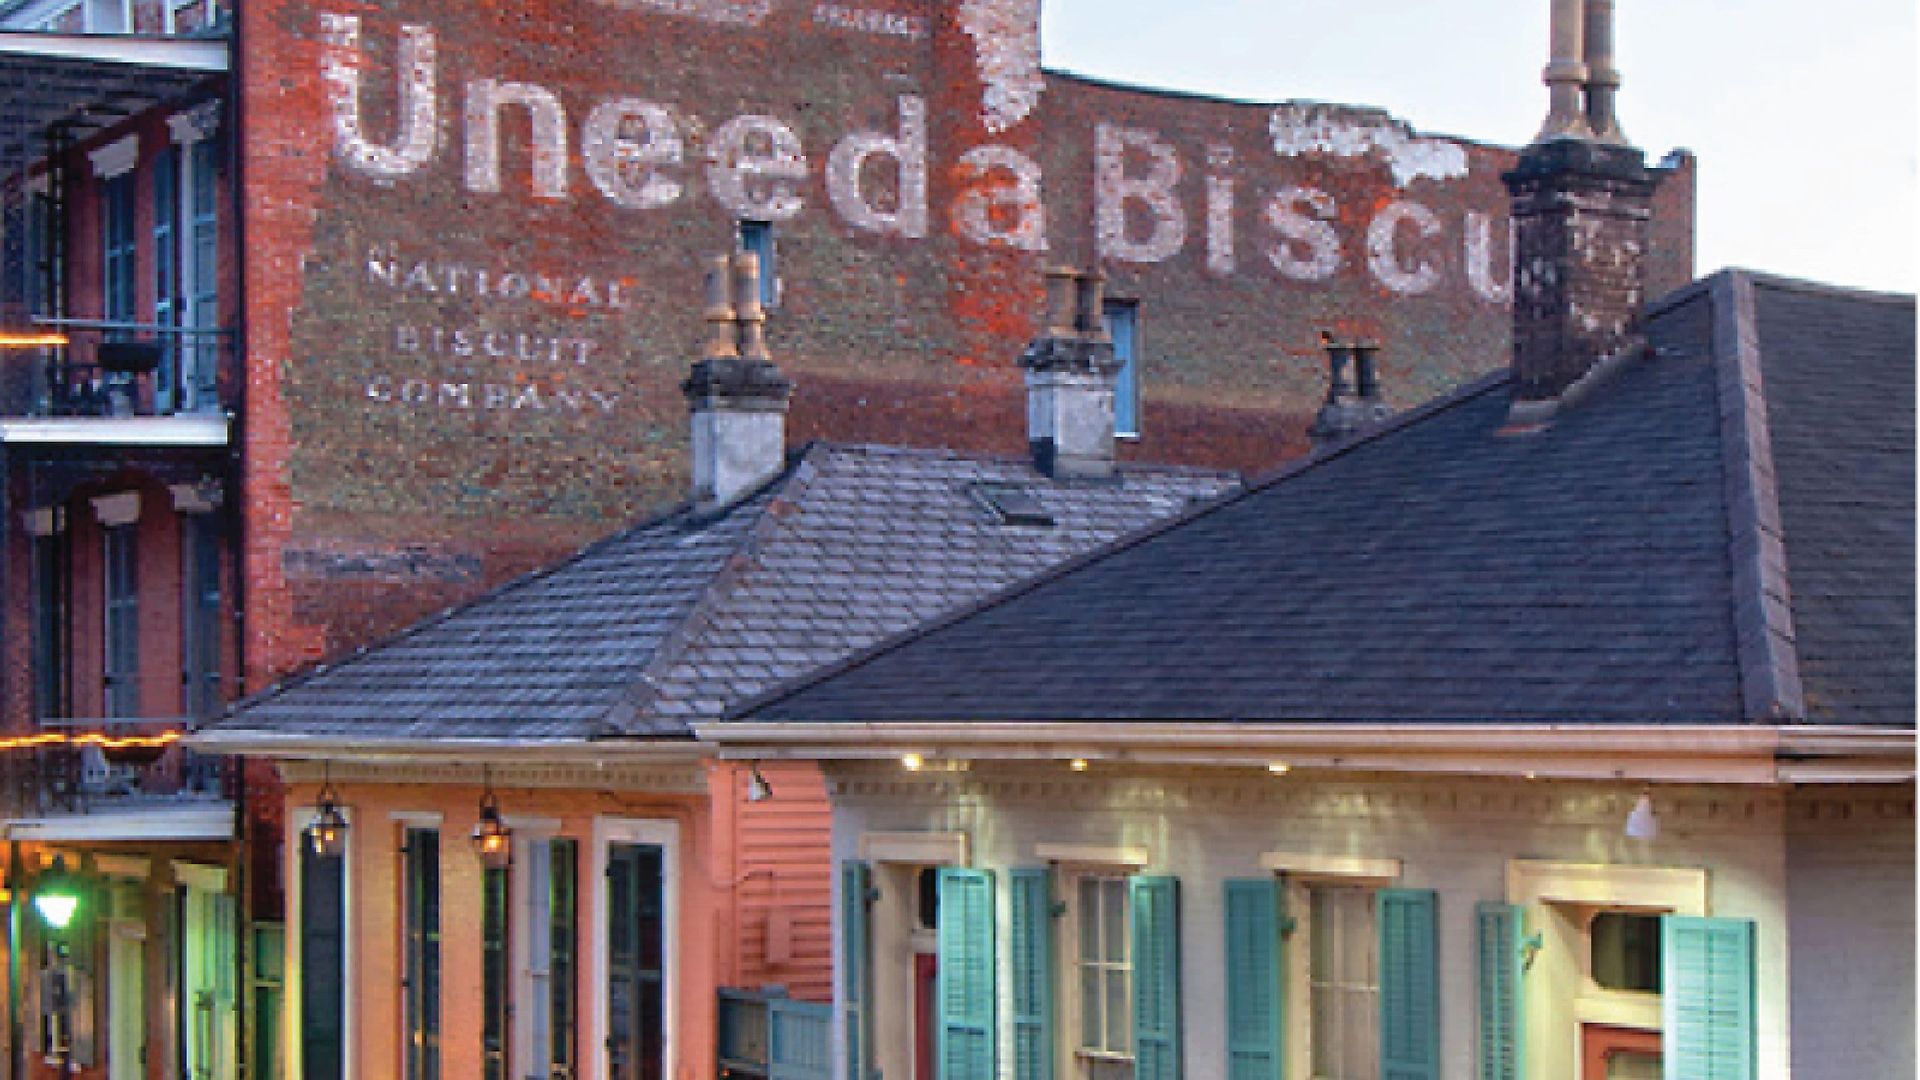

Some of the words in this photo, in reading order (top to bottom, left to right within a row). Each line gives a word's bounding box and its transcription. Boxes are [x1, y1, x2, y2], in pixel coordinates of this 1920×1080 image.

[320, 12, 1049, 252] Uneeda
[366, 257, 628, 309] NATIONAL
[396, 325, 599, 365] BISCUIT
[365, 374, 620, 413] COMPANY
